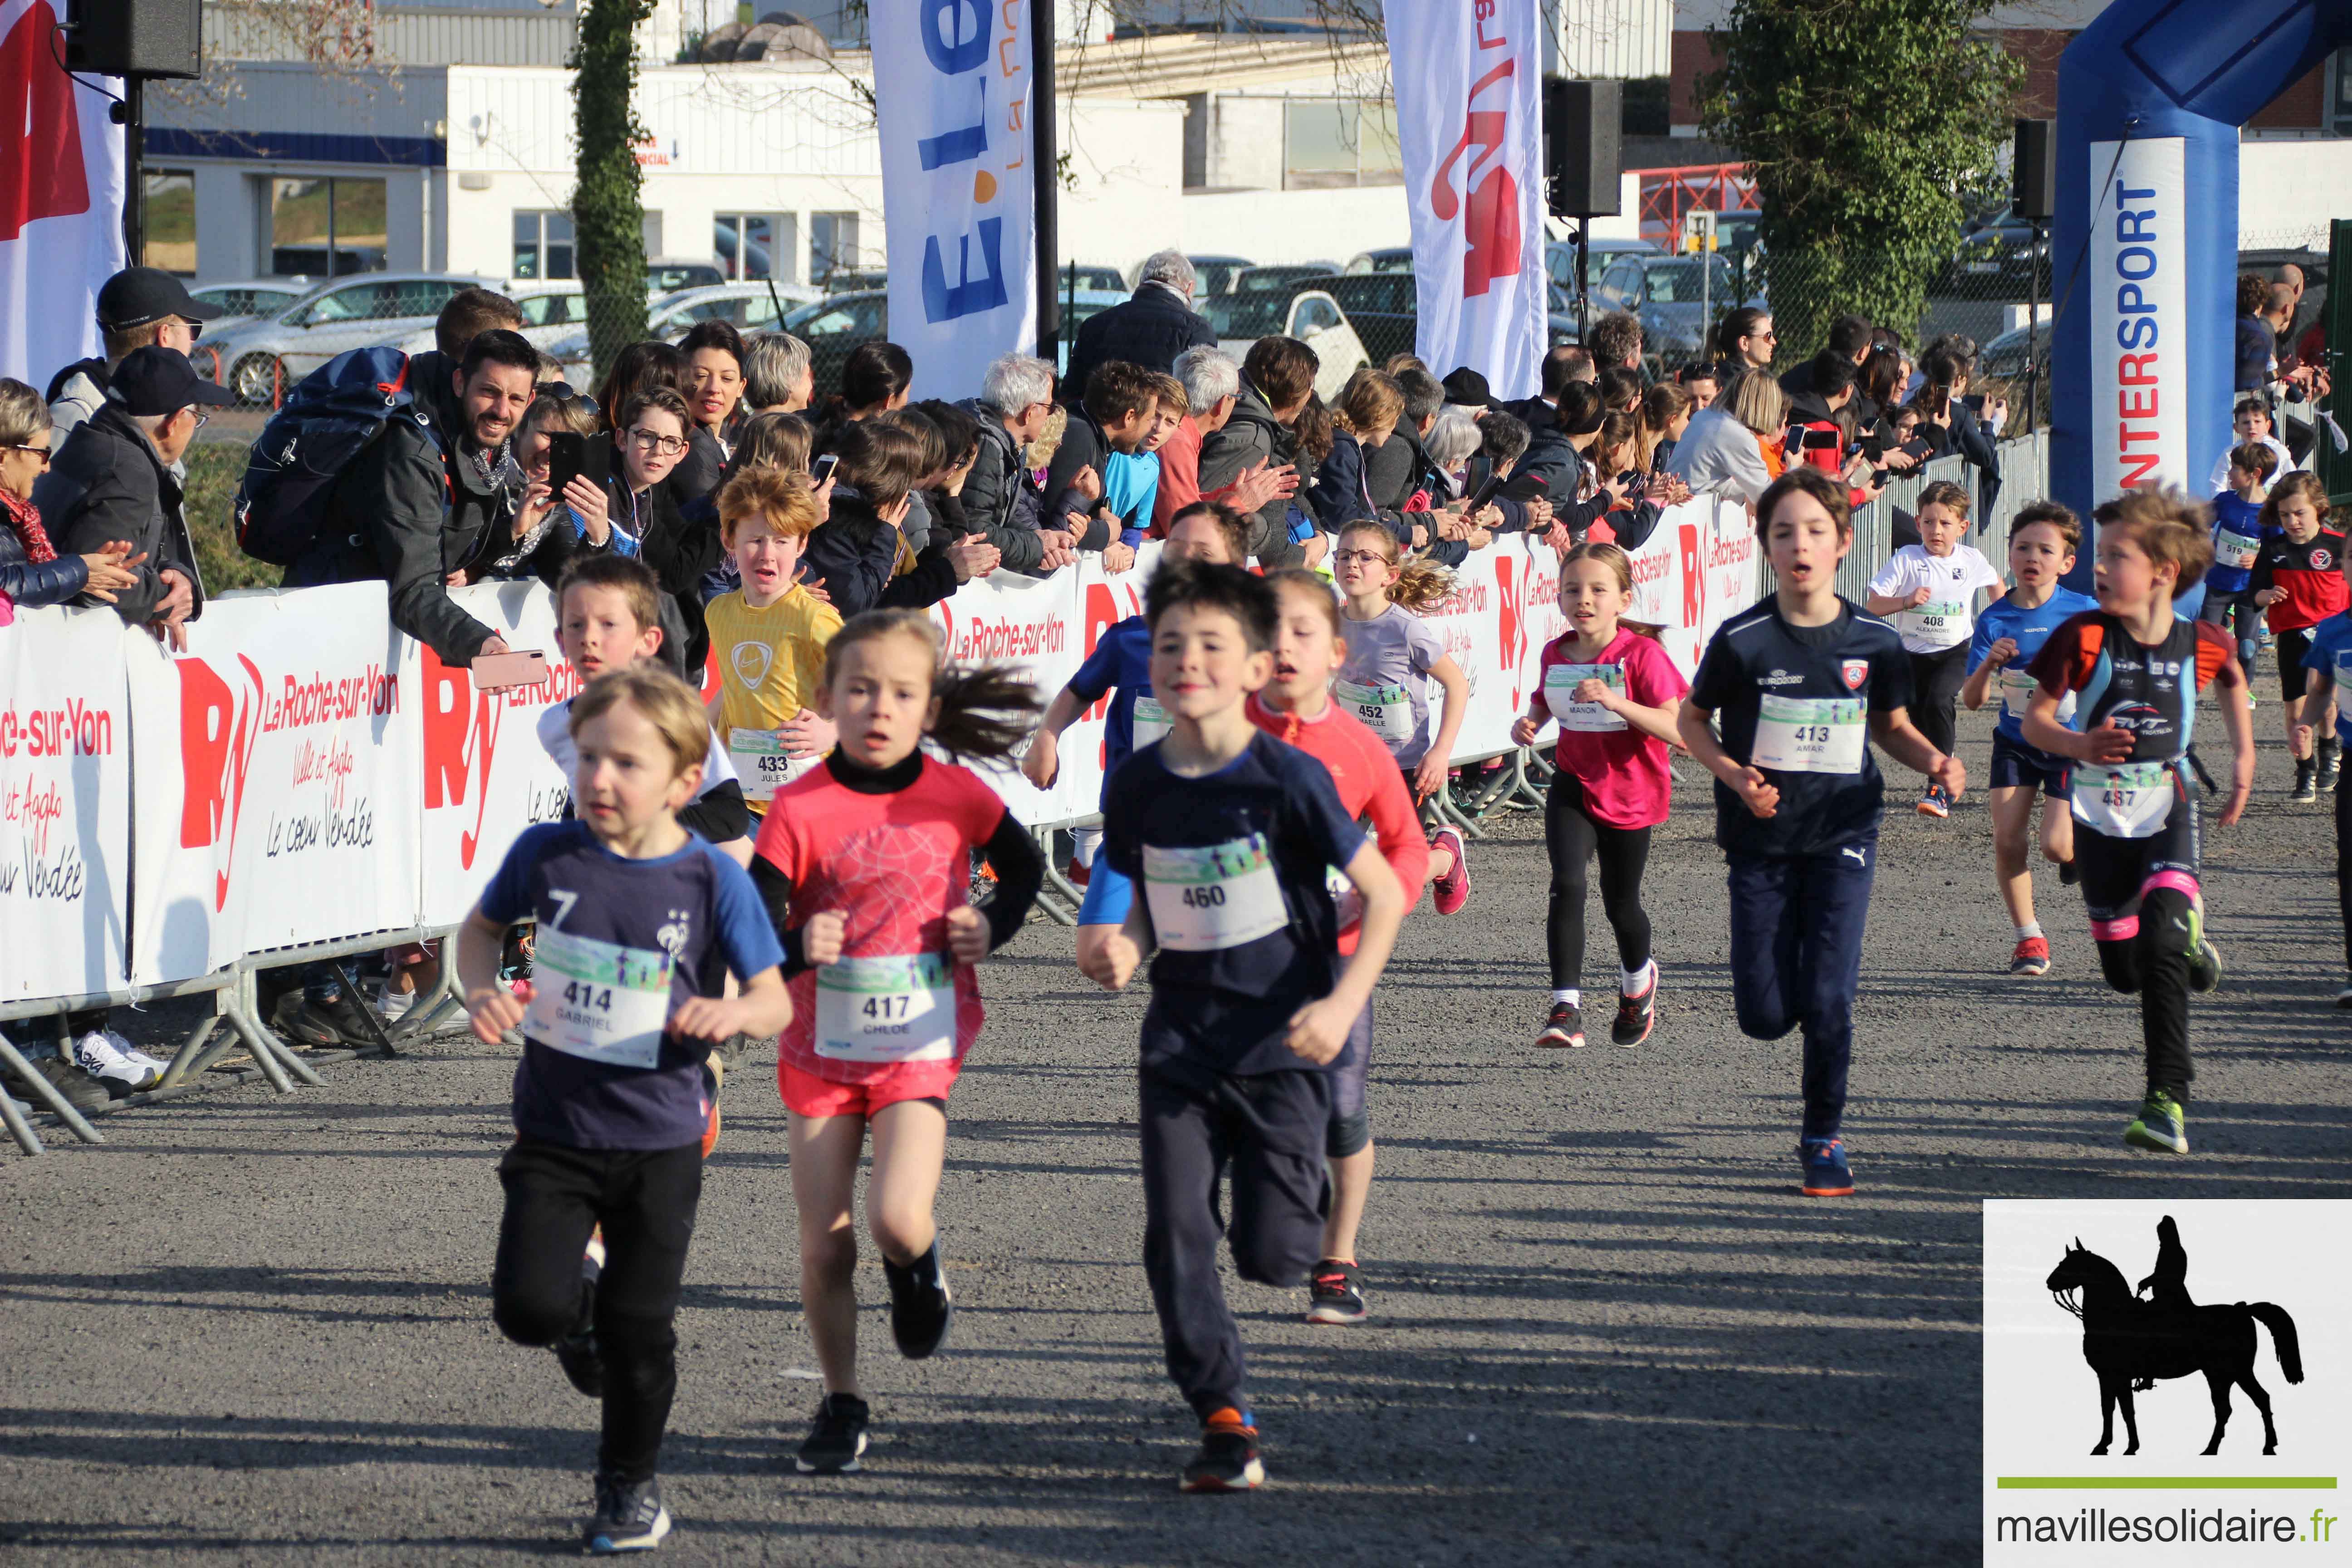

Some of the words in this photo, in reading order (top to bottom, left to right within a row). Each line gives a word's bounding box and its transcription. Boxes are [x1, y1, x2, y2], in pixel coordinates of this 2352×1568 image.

[2116, 179, 2160, 488] NTERSPORT
[2226, 544, 2242, 554] 519
[1924, 617, 1944, 626] 408
[1359, 705, 1383, 718] 452
[1795, 726, 1829, 742] 413
[758, 756, 788, 771] 433
[1183, 885, 1225, 908] 460
[548, 890, 578, 930] 7
[564, 980, 611, 1012] 414
[863, 996, 909, 1018] 417
[556, 1008, 612, 1032] GABRIEL
[863, 1025, 910, 1034] CHLOE
